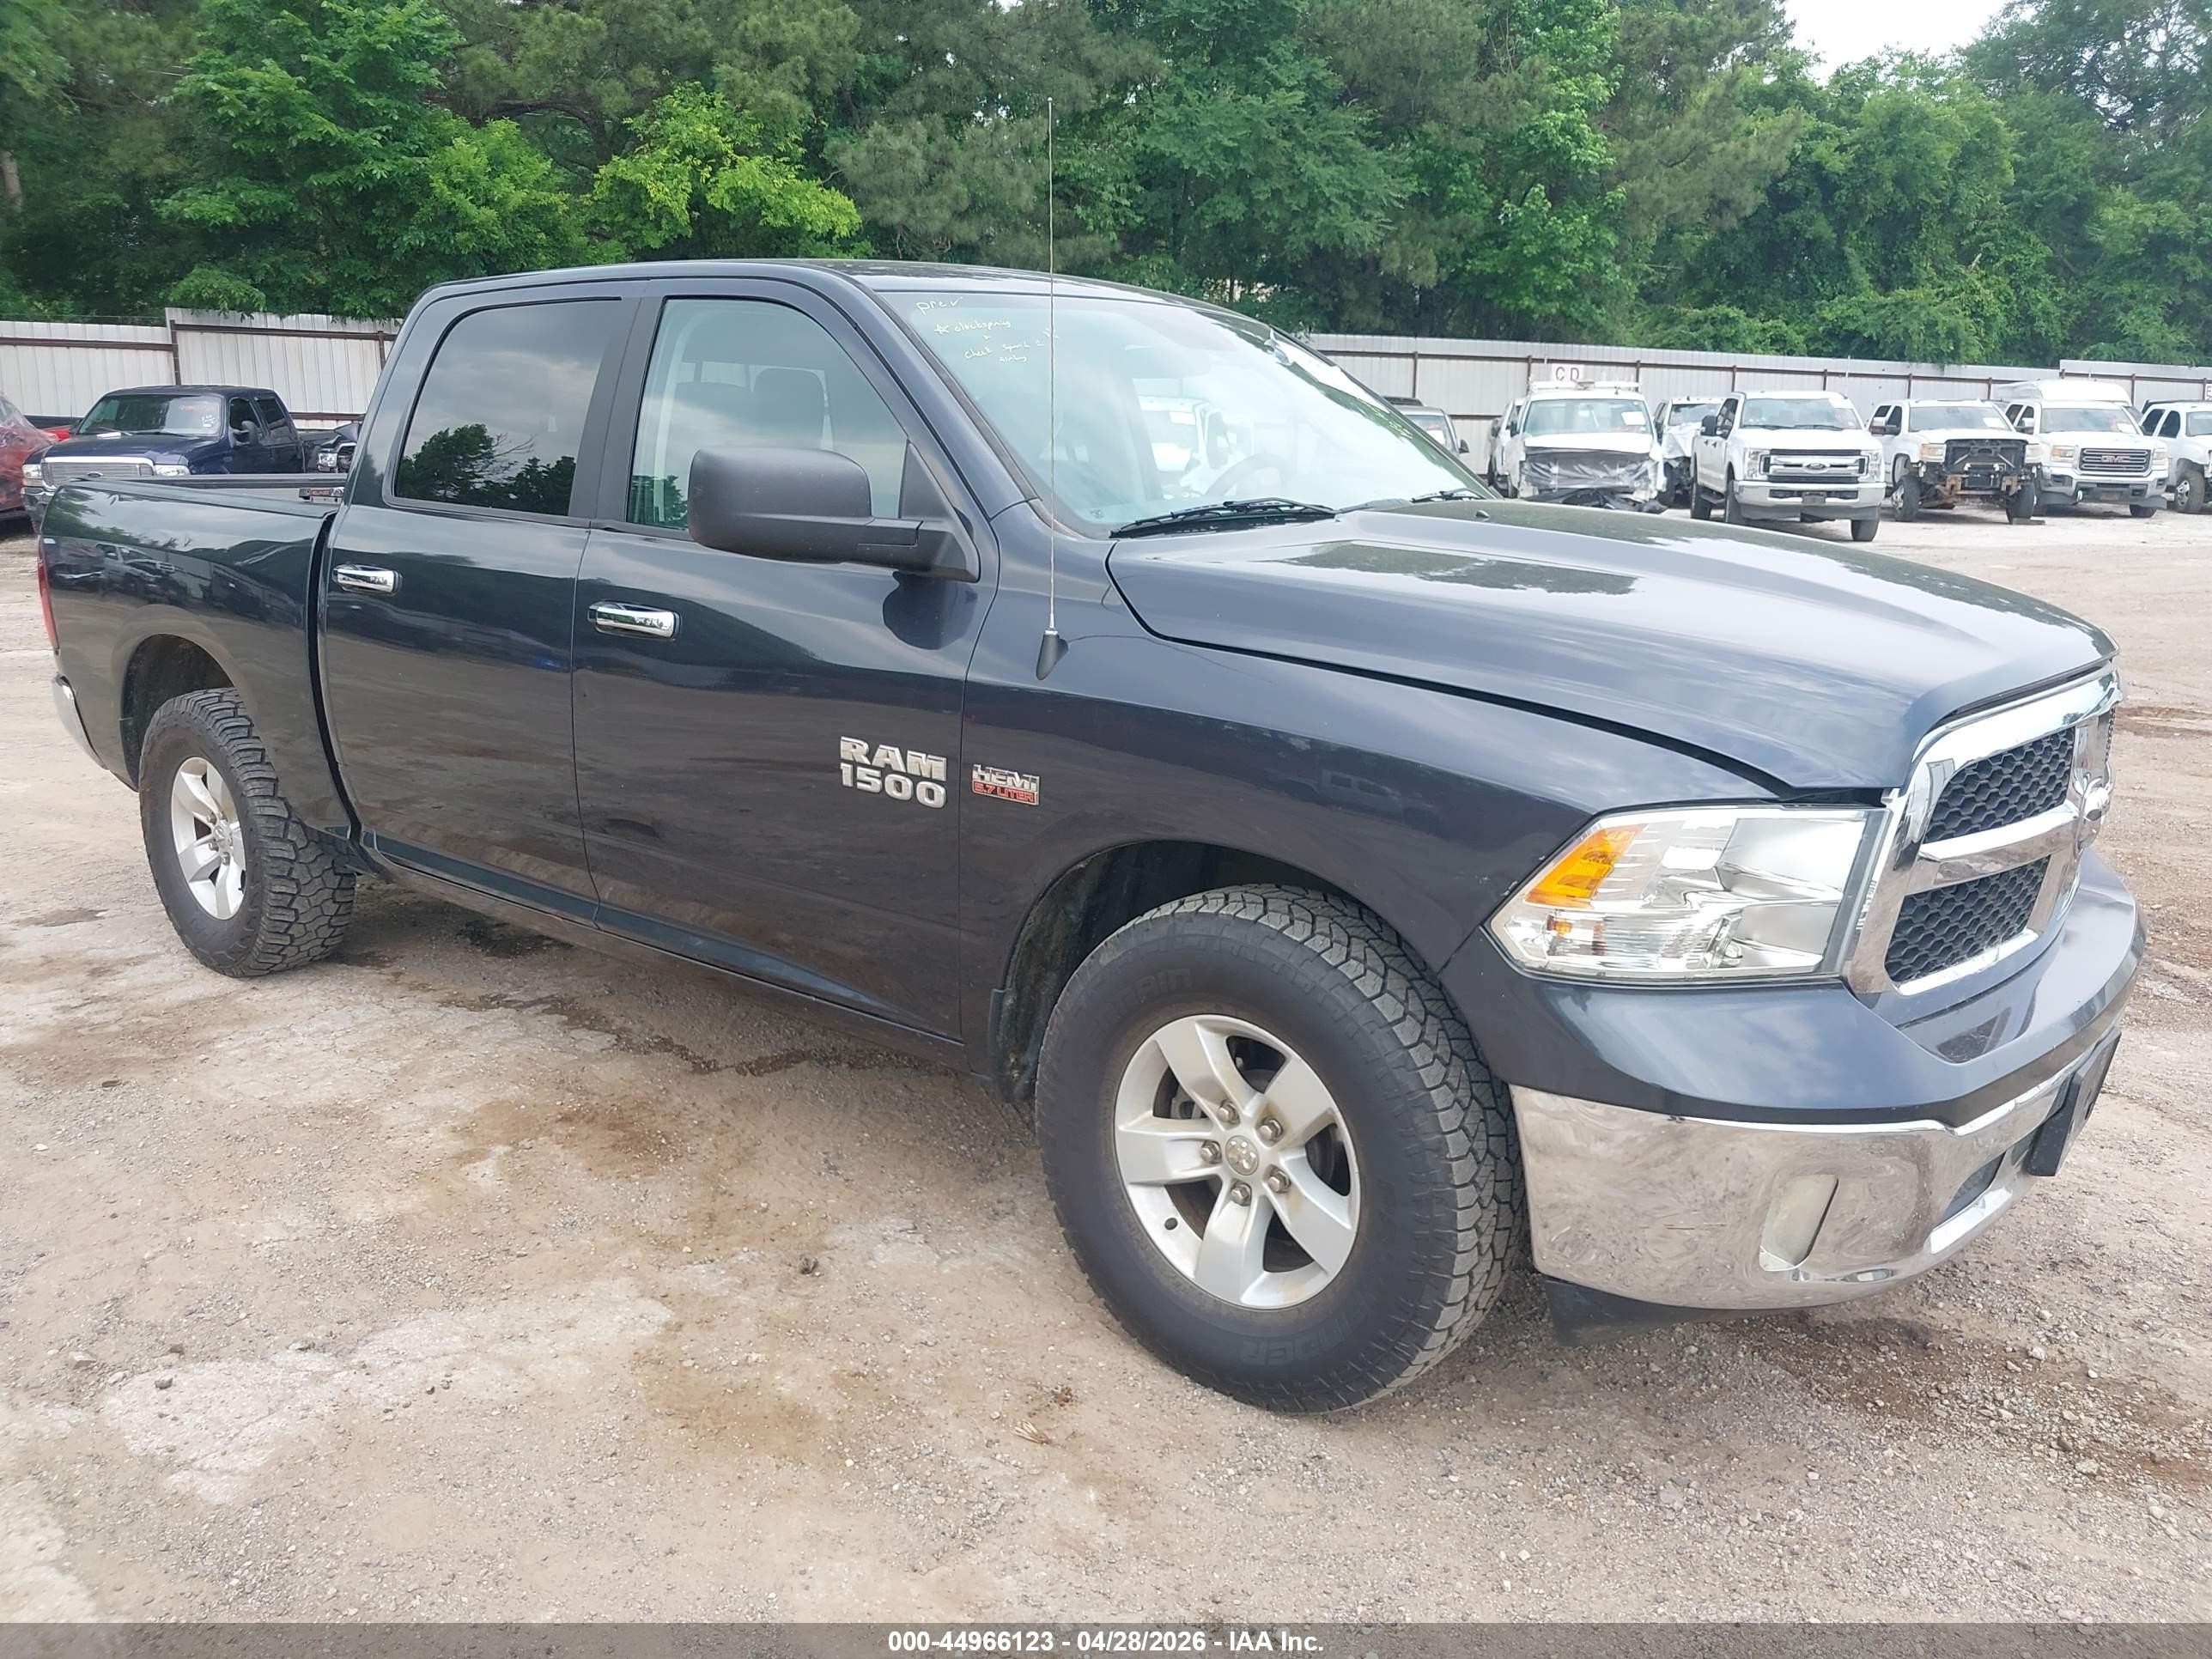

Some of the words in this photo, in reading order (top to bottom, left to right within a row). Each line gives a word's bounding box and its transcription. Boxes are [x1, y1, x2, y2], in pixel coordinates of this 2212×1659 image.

[840, 736, 947, 781] RAM
[840, 763, 947, 809] 1500
[972, 763, 1040, 792] HEMI
[974, 782, 996, 794] 5.7
[996, 786, 1036, 803] LITER
